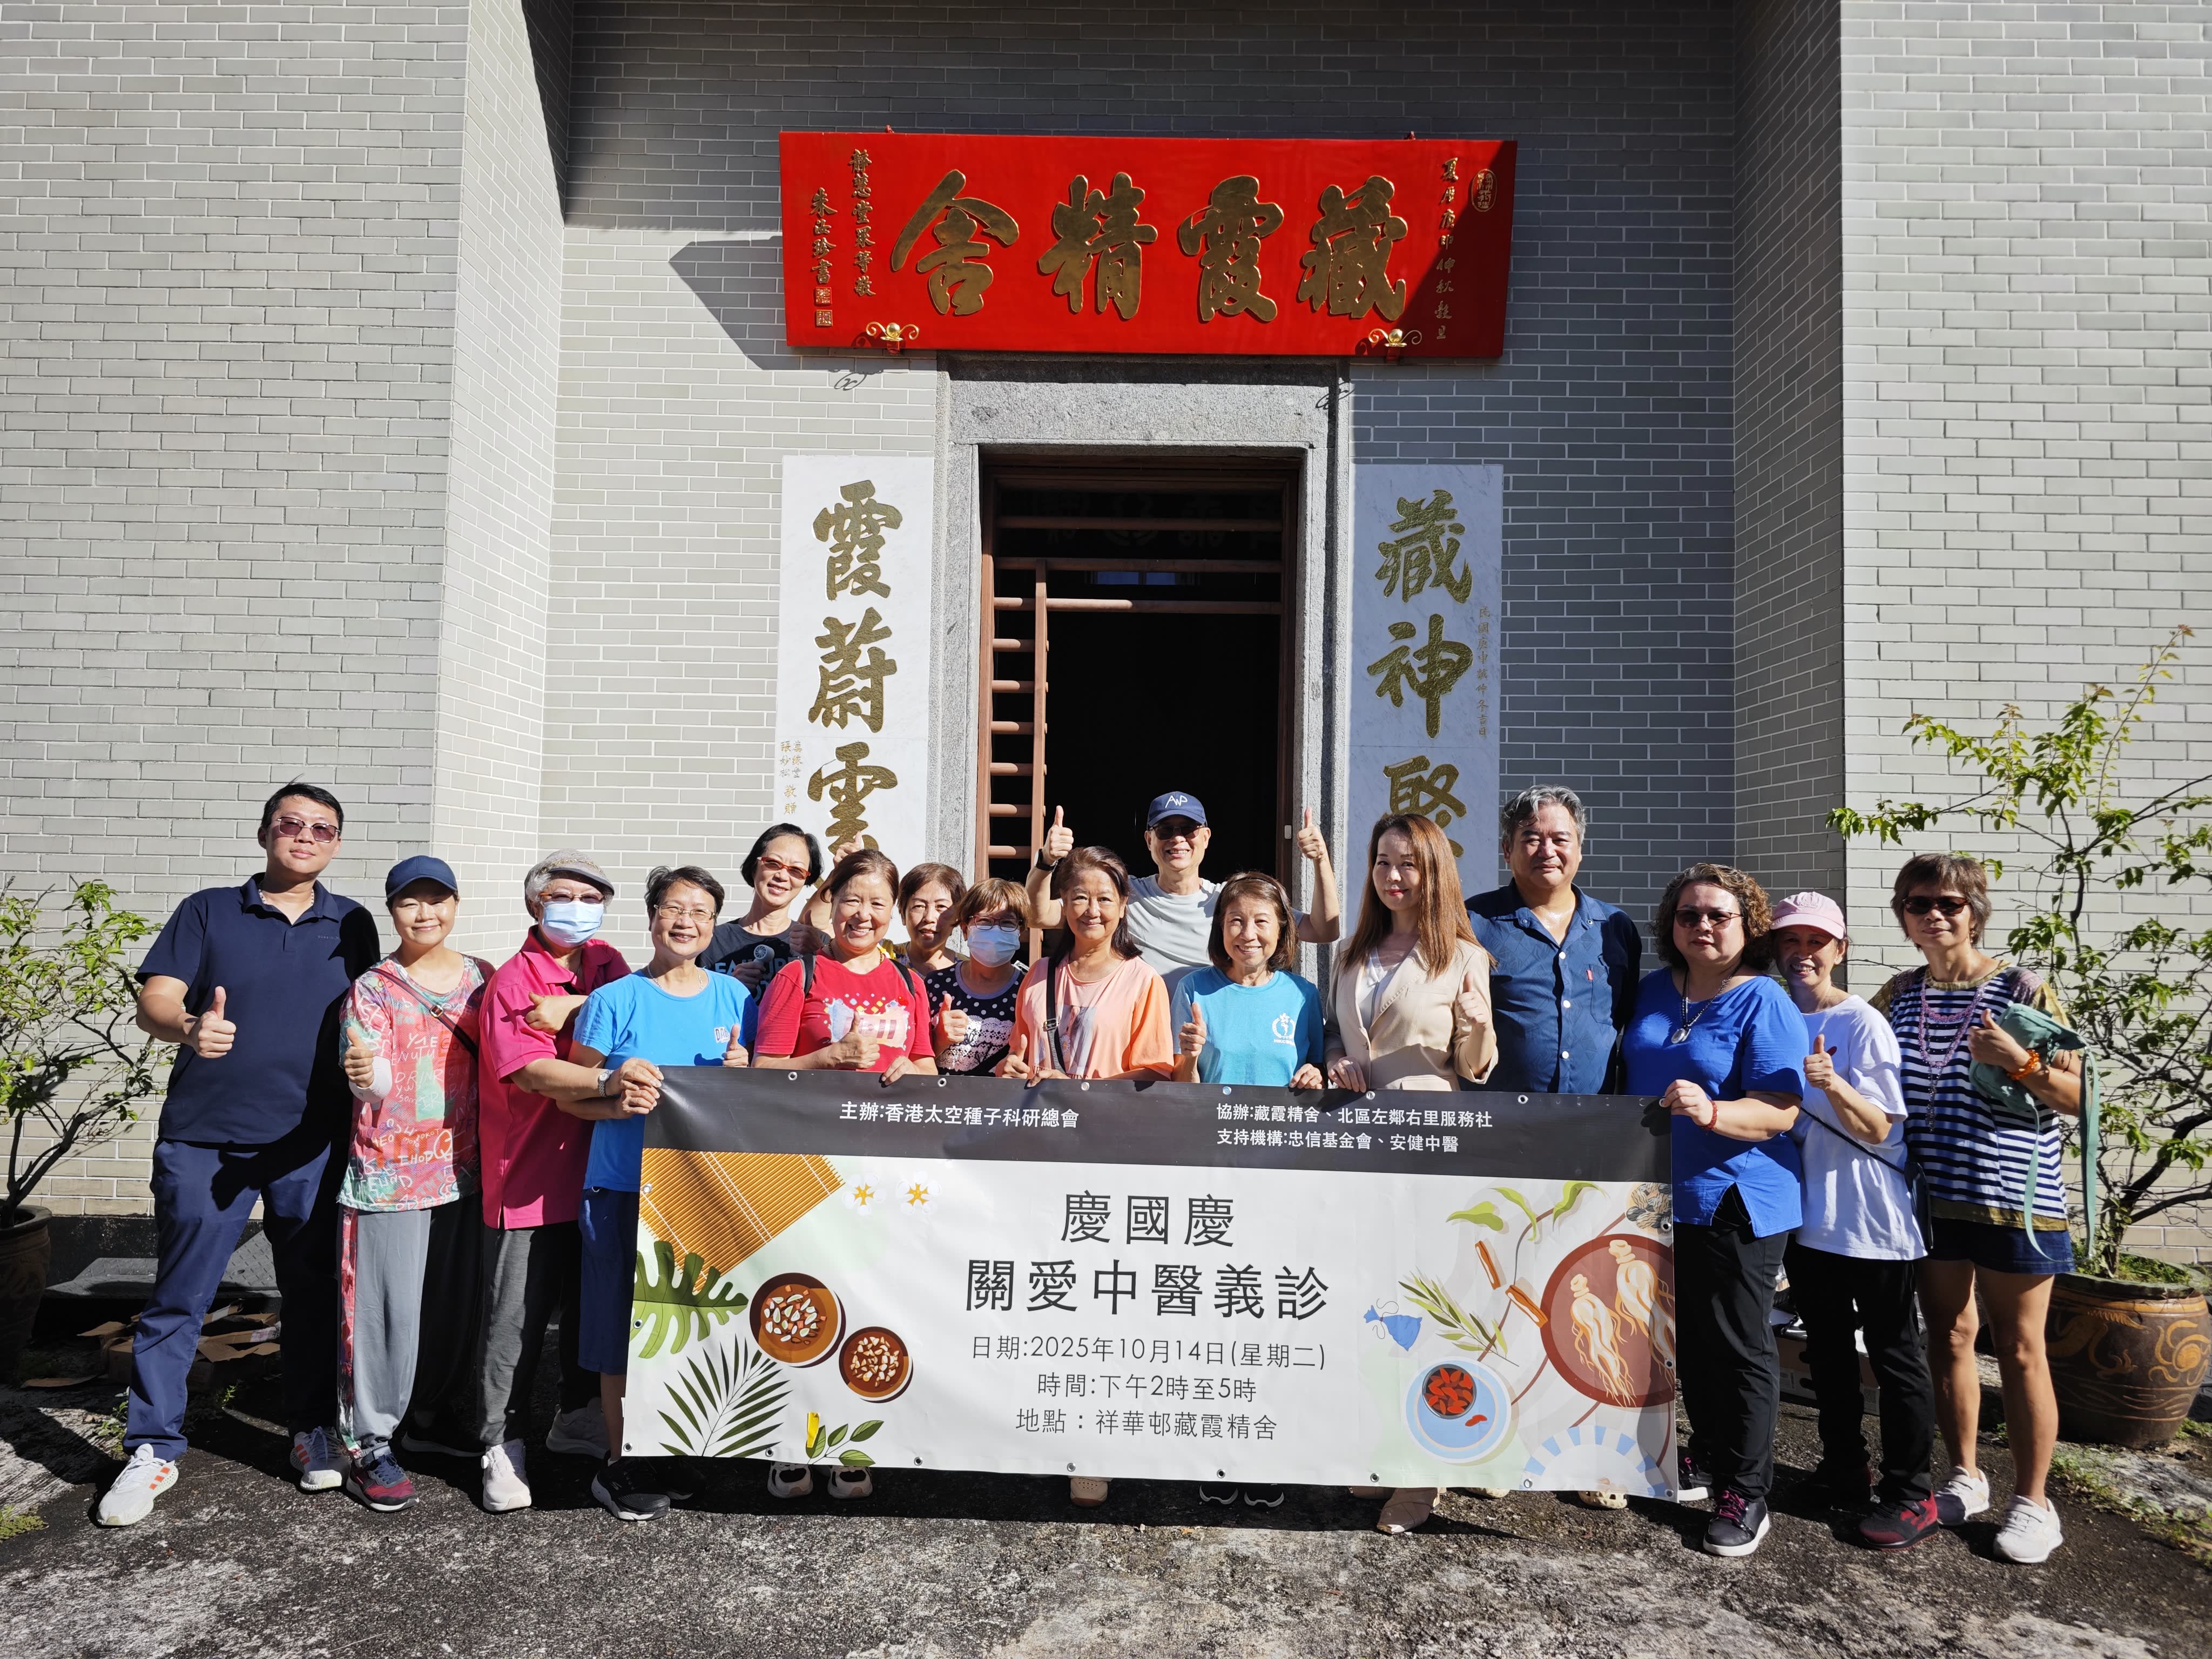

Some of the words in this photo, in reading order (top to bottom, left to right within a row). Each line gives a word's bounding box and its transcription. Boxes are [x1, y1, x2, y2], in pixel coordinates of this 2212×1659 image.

[891, 168, 1408, 324] 藏霞精舍
[806, 480, 902, 903] 霞蔚雲
[839, 1101, 1080, 1128] 主辦:香港太空種子科研總會
[1216, 1103, 1493, 1128] 協辦:藏霞精舍、北區左鄰右里服務社
[1217, 1128, 1459, 1152] 支持機構:忠信基金會、安健中醫
[1061, 1190, 1235, 1247] 慶國慶
[966, 1259, 1329, 1320] 關愛中醫義診
[973, 1336, 1325, 1370] 日期:2025年10月14日(星期二)
[1037, 1372, 1257, 1402] 時間:下午2時至5時
[1015, 1408, 1277, 1440] 地點：祥華邨藏霞精舍
